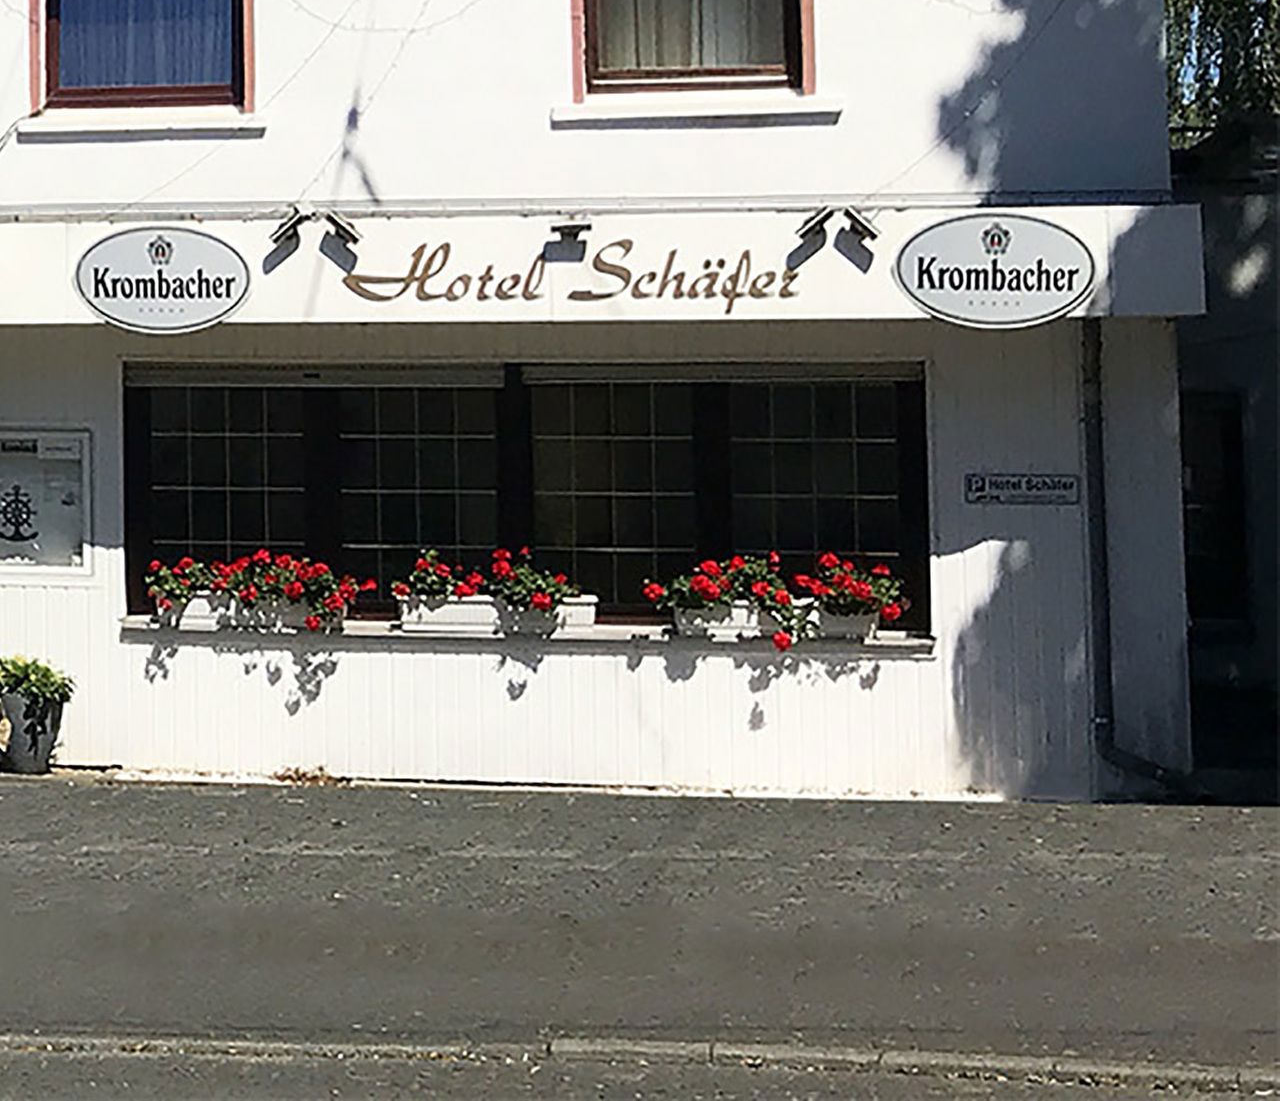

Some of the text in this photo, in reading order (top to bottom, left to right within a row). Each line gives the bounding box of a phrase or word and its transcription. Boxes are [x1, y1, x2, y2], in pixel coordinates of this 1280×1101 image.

[92, 267, 236, 299] Krombacher
[342, 238, 801, 315] Hotel Schäfer
[916, 256, 1080, 292] Krombacher
